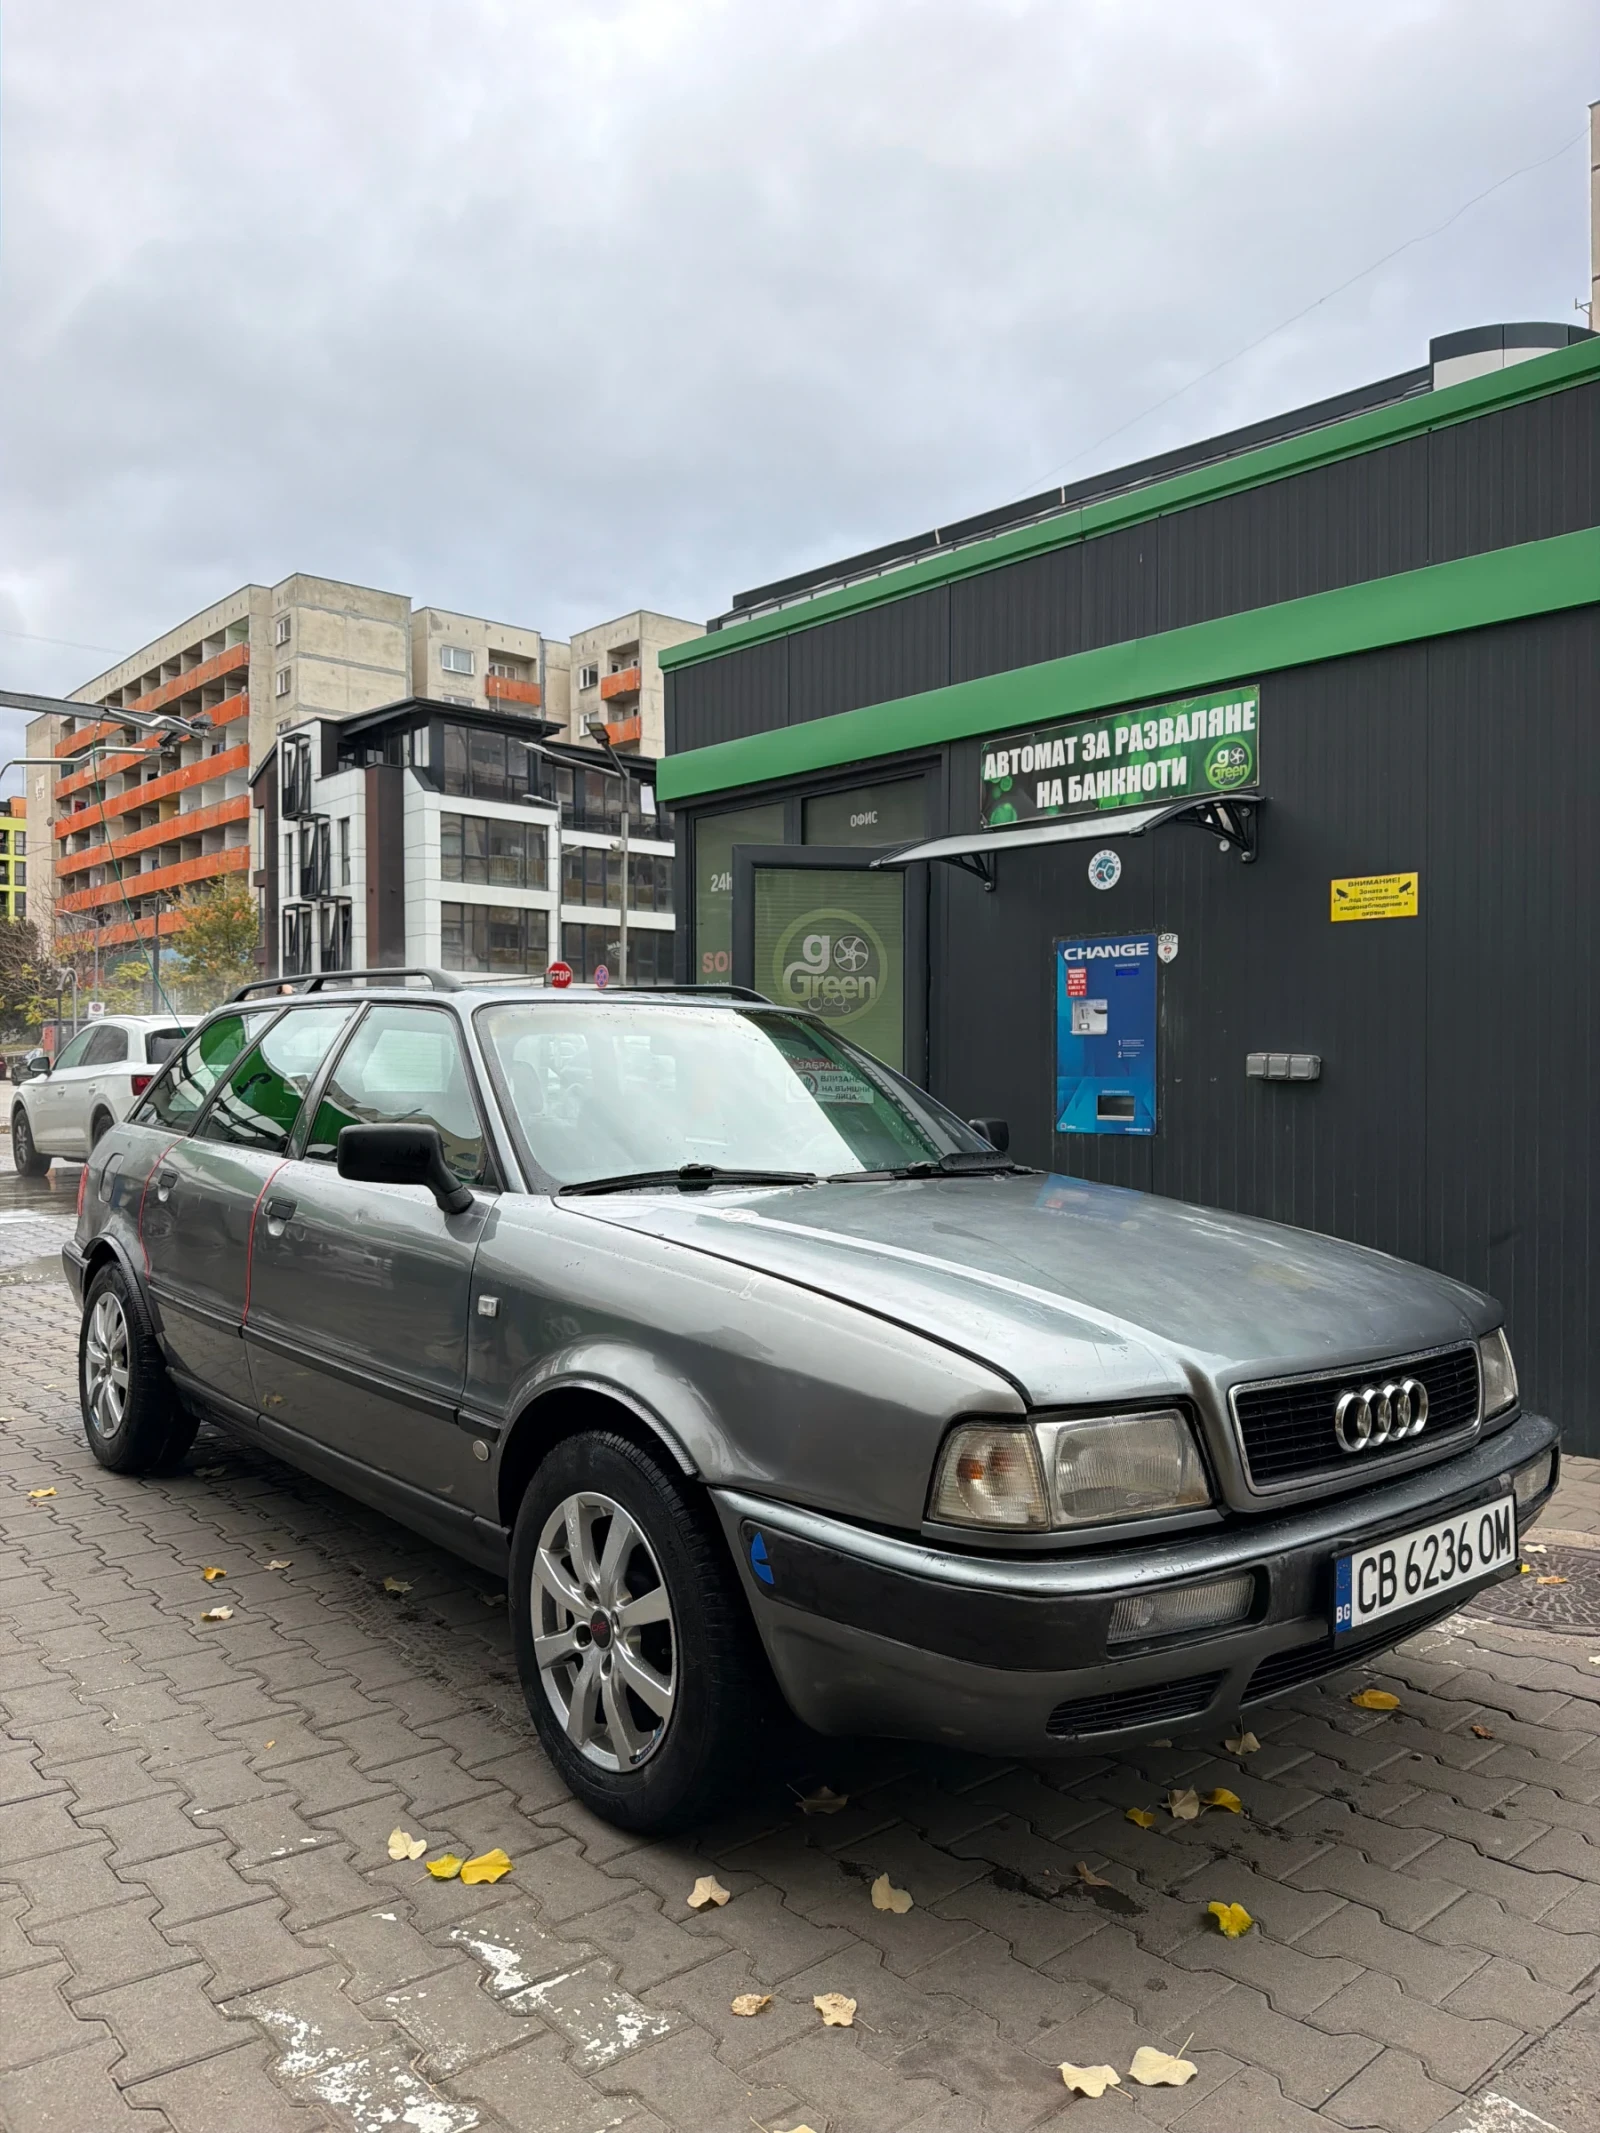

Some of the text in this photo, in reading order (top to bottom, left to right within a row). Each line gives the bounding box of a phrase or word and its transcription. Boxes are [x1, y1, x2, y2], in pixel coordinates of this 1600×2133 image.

[983, 700, 1256, 780] АВТОМАТ ЗА РАЗВАЛЯНЕ
[1036, 756, 1187, 808] НА БАНКНОТИ
[1209, 763, 1248, 781] Green
[850, 811, 878, 827] ОФИС
[1348, 877, 1401, 888] ВНИМАНИЕ!
[1063, 942, 1149, 961] CHANGE
[783, 961, 878, 1001] Green
[1358, 1504, 1511, 1614] CB 6236 OM
[1336, 1603, 1351, 1623] BG
